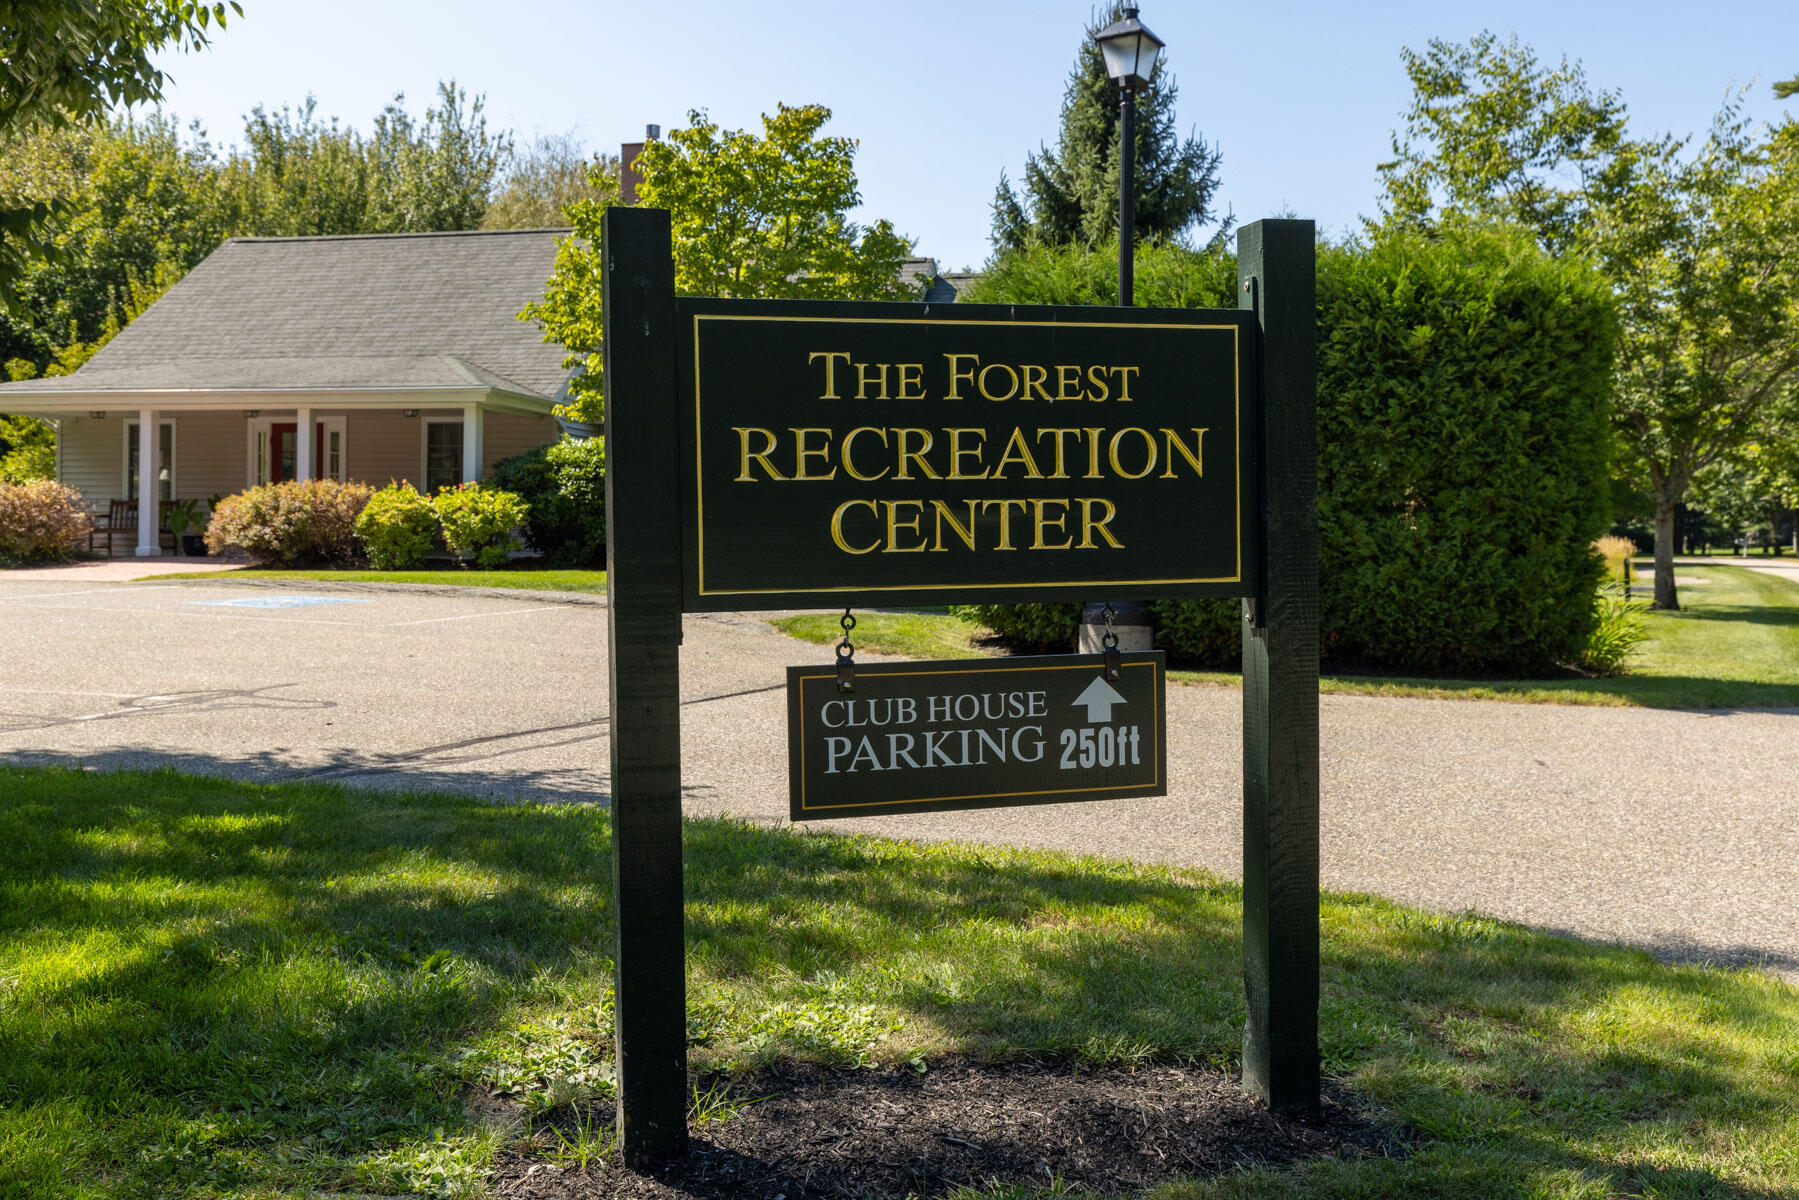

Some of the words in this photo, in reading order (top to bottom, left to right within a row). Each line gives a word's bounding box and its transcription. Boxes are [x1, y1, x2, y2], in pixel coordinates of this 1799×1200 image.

[808, 352, 927, 401] THE
[942, 353, 1140, 403] FOREST
[731, 426, 1210, 482] RECREATION
[830, 498, 1126, 555] CENTER
[821, 698, 917, 728] CLUB
[926, 691, 1049, 724] HOUSE
[823, 725, 1048, 774] PARKING
[1059, 724, 1141, 770] 250ft
